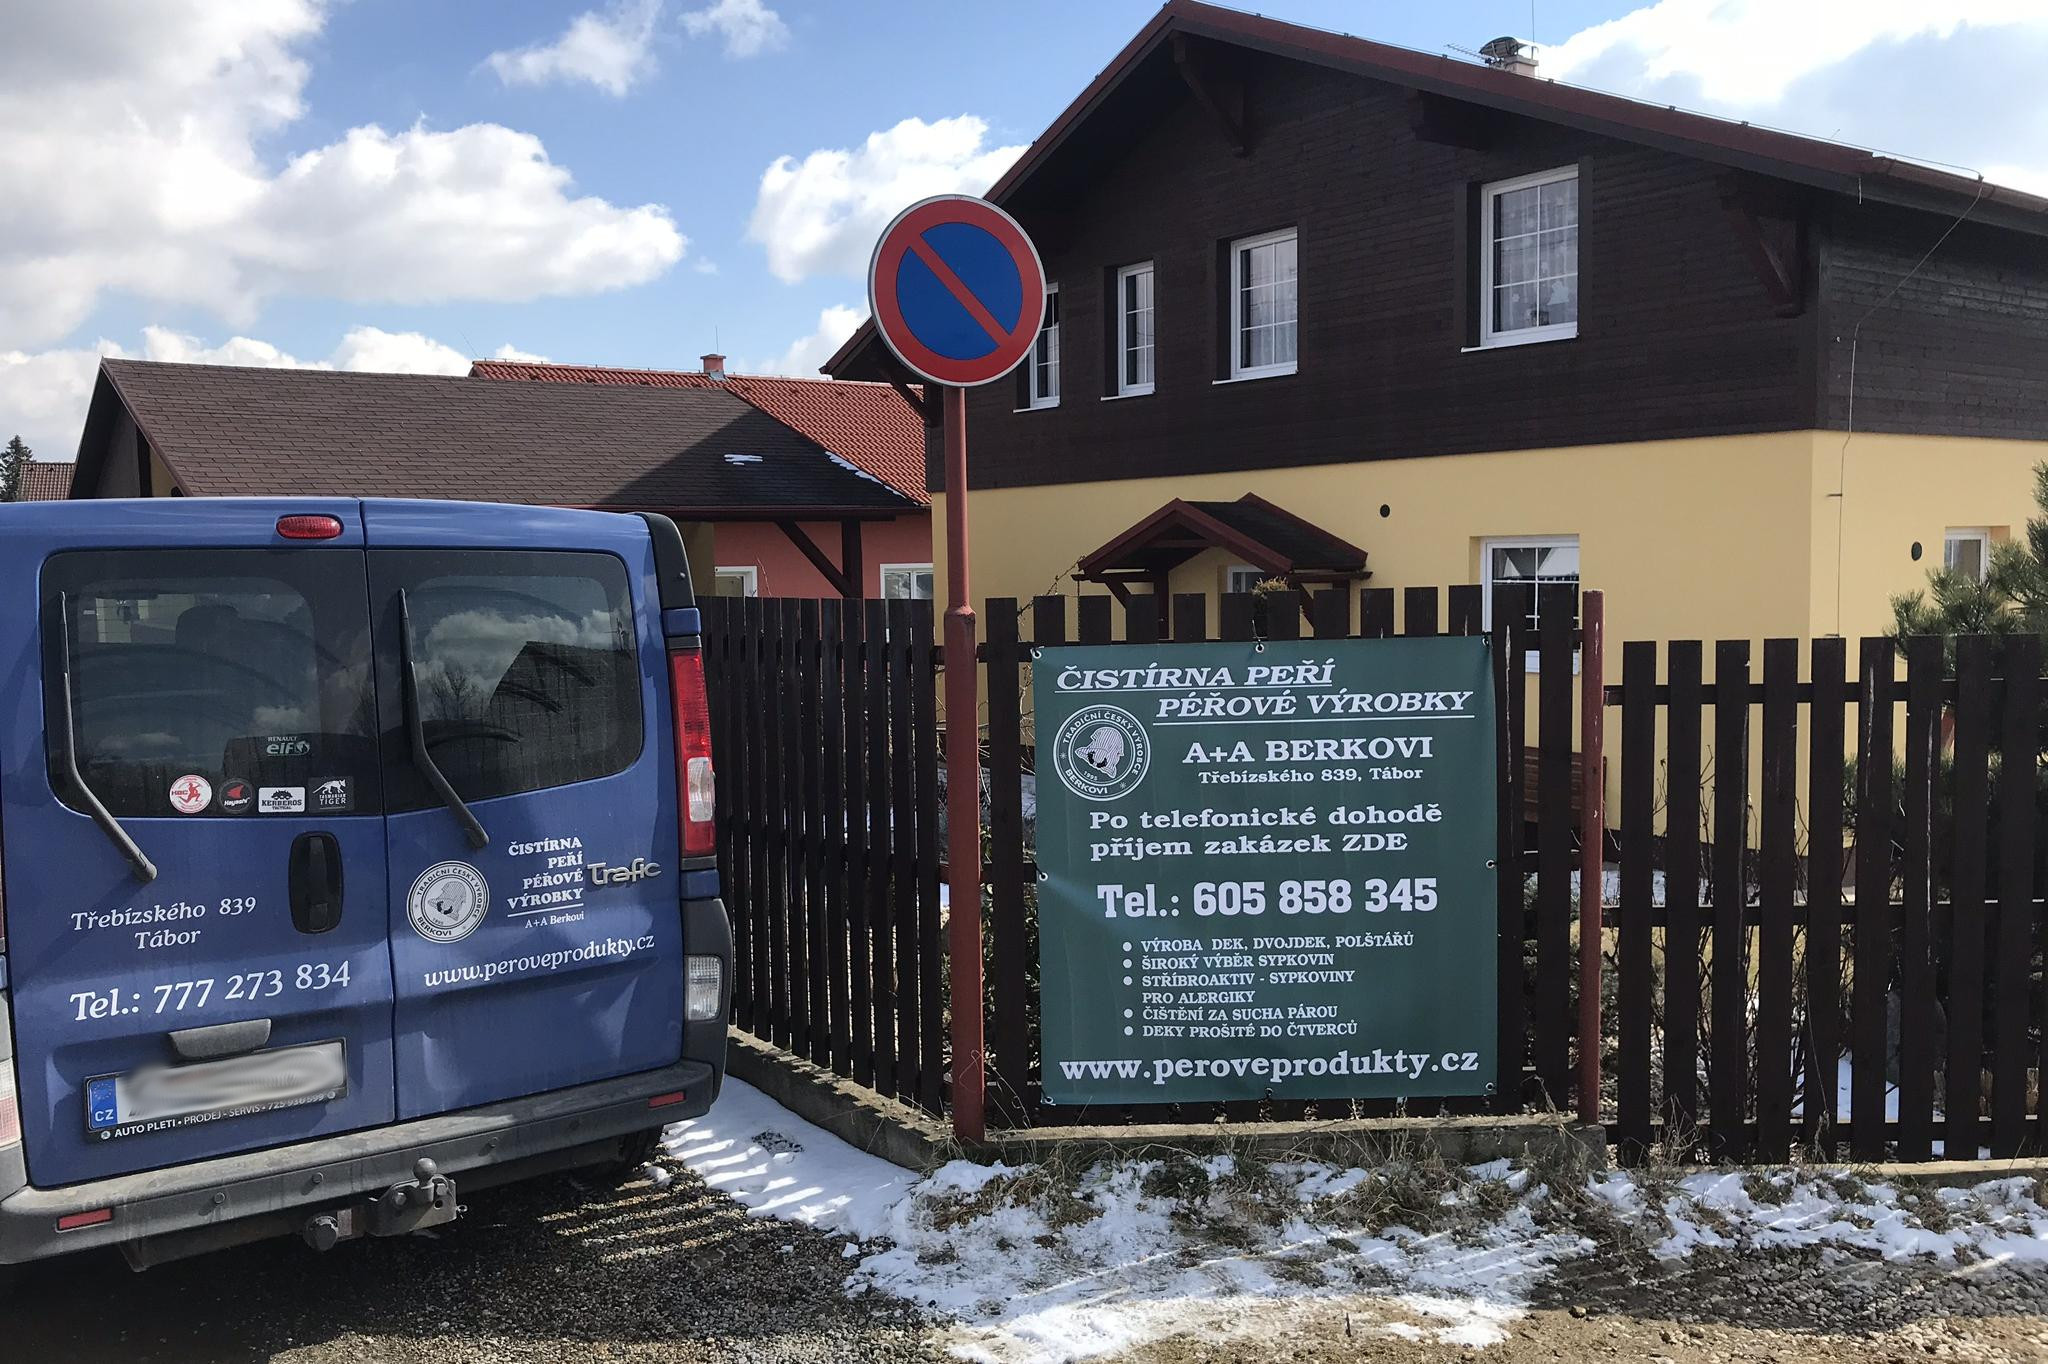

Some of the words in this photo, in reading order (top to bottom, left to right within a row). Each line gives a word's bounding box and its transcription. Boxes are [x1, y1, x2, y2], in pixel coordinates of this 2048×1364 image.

[1056, 664, 1234, 691] ČISTÍRNA
[1244, 658, 1336, 687] PEŘÍ
[1156, 691, 1297, 718] PÉŘOVÉ
[1307, 687, 1475, 714] VÝROBKY
[1182, 742, 1255, 764] A+A
[1265, 737, 1434, 762] BERKOVI
[1065, 768, 1108, 794] BERKOVI
[1198, 768, 1315, 784] Třebízského
[1321, 766, 1362, 783] 839,
[1369, 766, 1424, 781] Tábor
[319, 797, 347, 805] TIGER
[1089, 811, 1129, 829] Po
[1140, 805, 1318, 828] telefonické
[1328, 803, 1443, 825] dohodě
[508, 836, 583, 856] ČISTÍRNA
[1090, 837, 1193, 862] příjem
[1204, 834, 1332, 854] zakázek
[1342, 833, 1408, 852] ZDE
[548, 851, 584, 870] PEŘÍ
[587, 857, 662, 886] Trafic
[523, 870, 584, 890] PÉŘOVÉ
[507, 888, 584, 910] VÝROBKY
[1097, 883, 1180, 918] Tel.:
[1193, 881, 1266, 917] 605
[1279, 879, 1352, 914] 858
[1364, 877, 1438, 912] 345
[70, 901, 206, 931] Třebízského
[219, 897, 257, 915] 839
[525, 916, 548, 929] A+A
[550, 911, 585, 925] Berkovi
[417, 917, 452, 937] BERKOVI
[134, 929, 201, 950] Tábor
[1141, 937, 1203, 953] VÝROBA
[1211, 938, 1248, 951] DEK,
[1253, 935, 1330, 950] DVOJDEK,
[1335, 930, 1415, 948] POLŠTÁŘŮ
[424, 935, 655, 987] www.peroveprodukty.cz
[1141, 954, 1199, 970] ŠIROKÝ
[1203, 953, 1254, 969] VÝBĚR
[1258, 953, 1334, 967] SYPKOVIN
[1141, 970, 1255, 988] STŘÍBROAKTIV
[1269, 970, 1355, 985] SYPKOVINY
[69, 988, 141, 1021] Tel.:
[153, 978, 215, 1014] 777
[225, 969, 284, 1000] 273
[295, 960, 351, 990] 834
[1142, 991, 1174, 1005] PRO
[1178, 990, 1255, 1004] ALERGIKY
[1142, 1004, 1204, 1021] ČIŠTĚNÍ
[1208, 1007, 1229, 1021] ZA
[1232, 1006, 1284, 1020] SUCHA
[1287, 1003, 1338, 1019] PÁROU
[1142, 1023, 1185, 1037] DEKY
[1189, 1022, 1256, 1037] PROŠITÉ
[1259, 1023, 1283, 1037] DO
[1286, 1019, 1358, 1036] ČTVERCŮ
[1059, 1048, 1479, 1085] www.peroveprodukty.cz
[94, 1108, 115, 1123] CZ
[114, 1125, 145, 1138] AUTO
[147, 1119, 176, 1133] PLETI
[184, 1111, 222, 1126] PRODEJ
[229, 1104, 261, 1118] SERVIS
